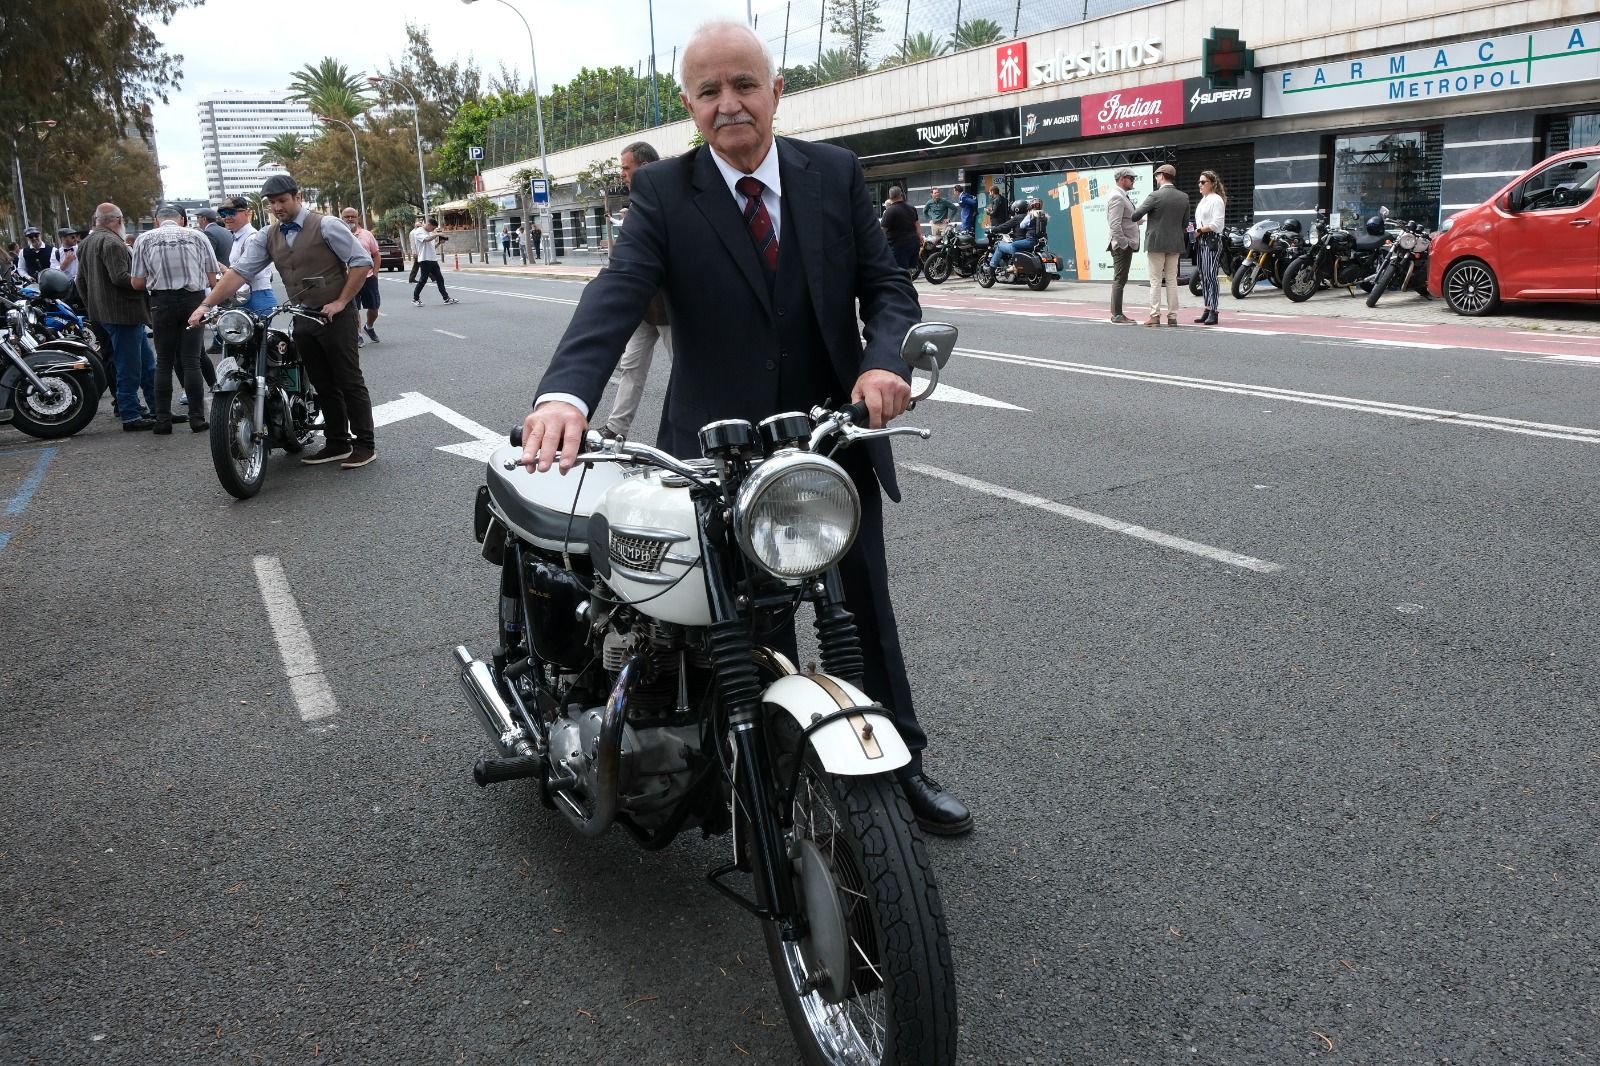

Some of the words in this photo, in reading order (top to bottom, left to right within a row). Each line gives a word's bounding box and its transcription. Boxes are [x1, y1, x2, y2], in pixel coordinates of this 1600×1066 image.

[1031, 37, 1163, 86] salesianos
[1389, 69, 1521, 100] METROPOL
[1200, 88, 1252, 104] SUPER73
[1098, 94, 1162, 122] Indian
[1053, 114, 1079, 125] AGUSTA
[1100, 118, 1160, 131] MOTORCYCLE
[916, 122, 959, 144] TRIUMPH
[472, 148, 481, 158] P
[612, 537, 651, 565] TRIUMPH
